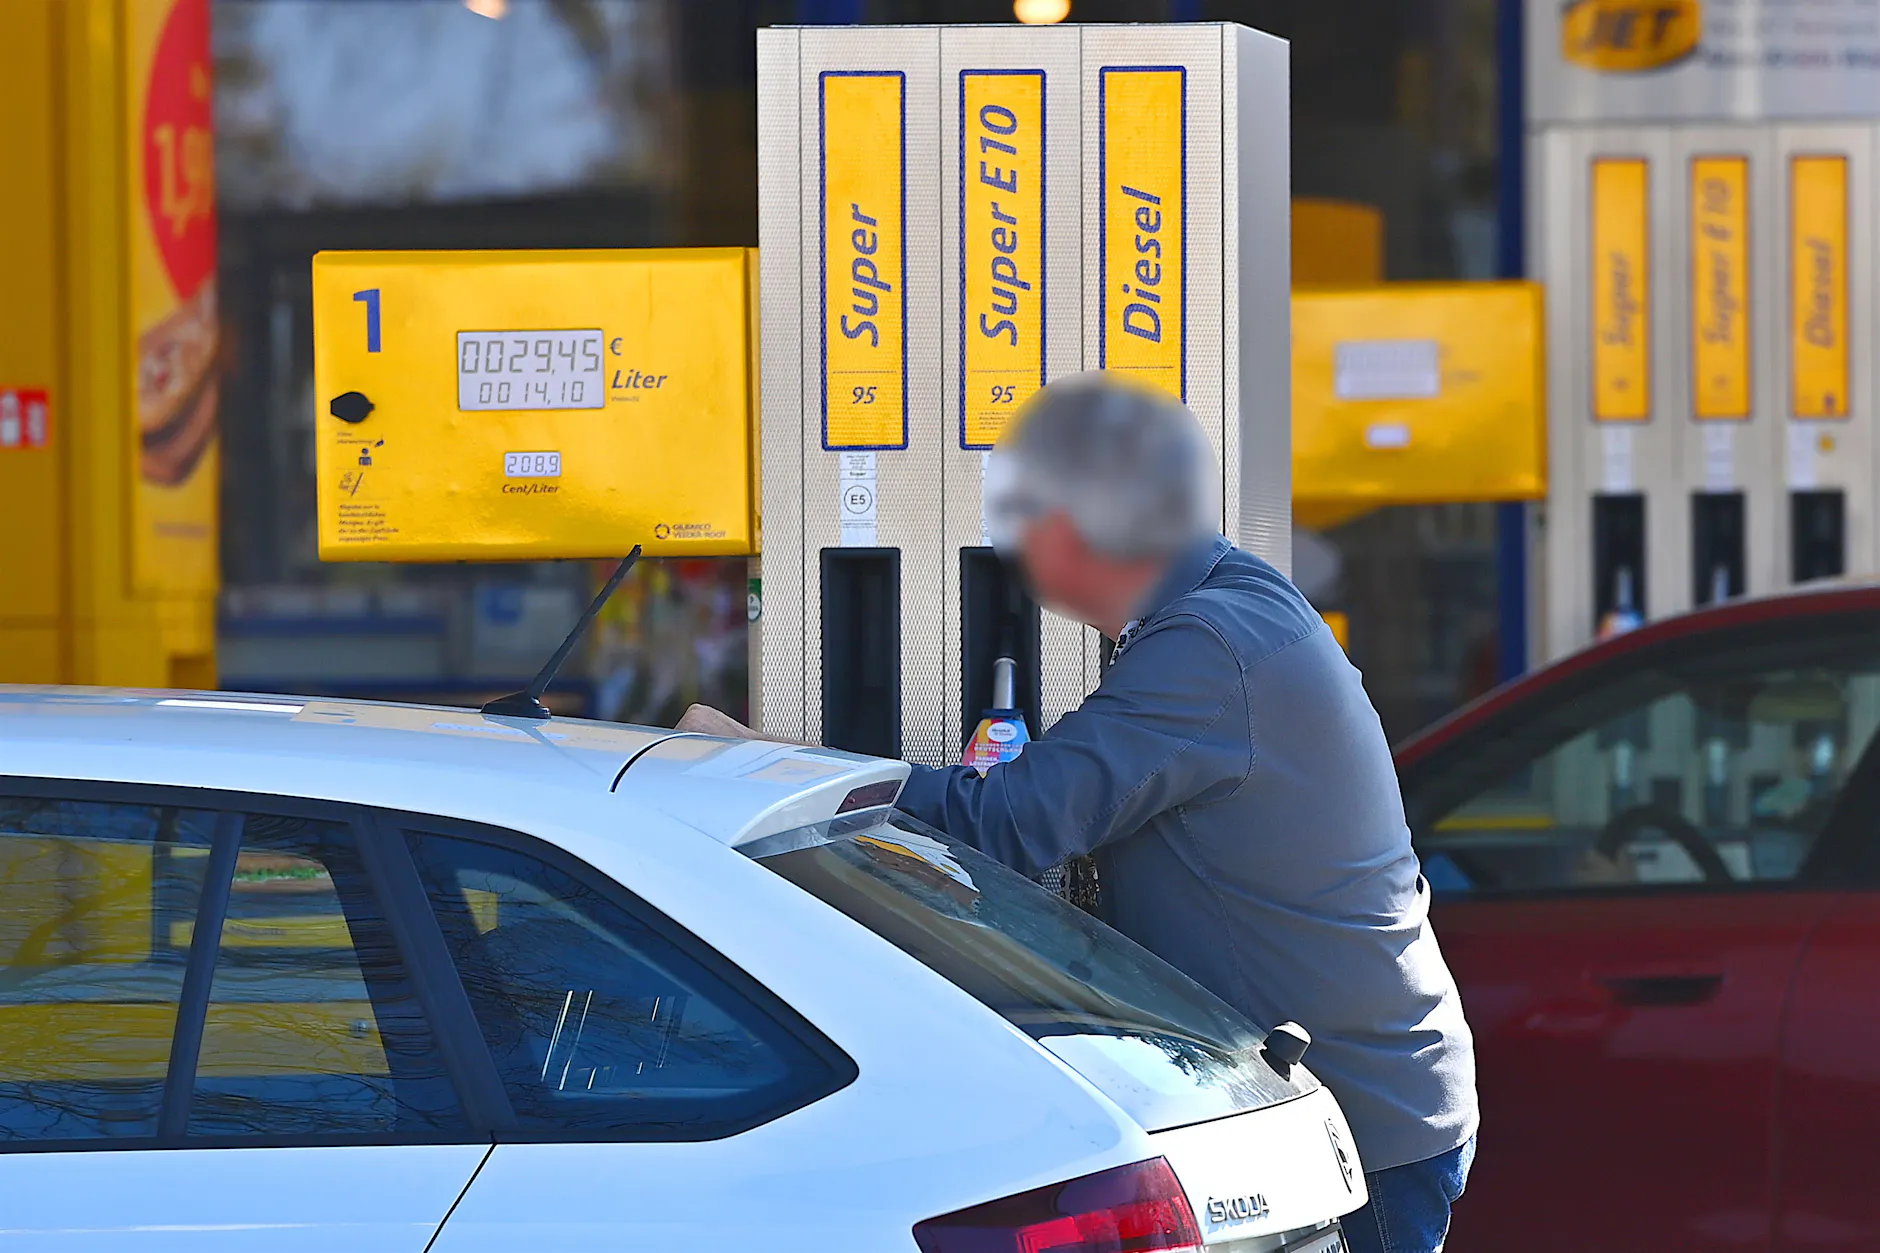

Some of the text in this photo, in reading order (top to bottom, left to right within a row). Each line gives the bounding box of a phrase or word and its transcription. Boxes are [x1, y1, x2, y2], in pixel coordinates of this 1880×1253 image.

[1121, 185, 1161, 343] Diesel
[840, 203, 892, 347] Super
[980, 201, 1032, 348] Super
[353, 288, 381, 353] 1
[610, 337, 624, 356] €
[461, 339, 600, 375] 0029,45
[612, 369, 668, 389] Liter
[479, 381, 584, 405] 0014,10
[852, 386, 877, 404] 95
[991, 385, 1016, 403] 95
[507, 455, 559, 475] 208,9
[502, 483, 560, 496] Cent/Liter
[850, 494, 866, 505] E5
